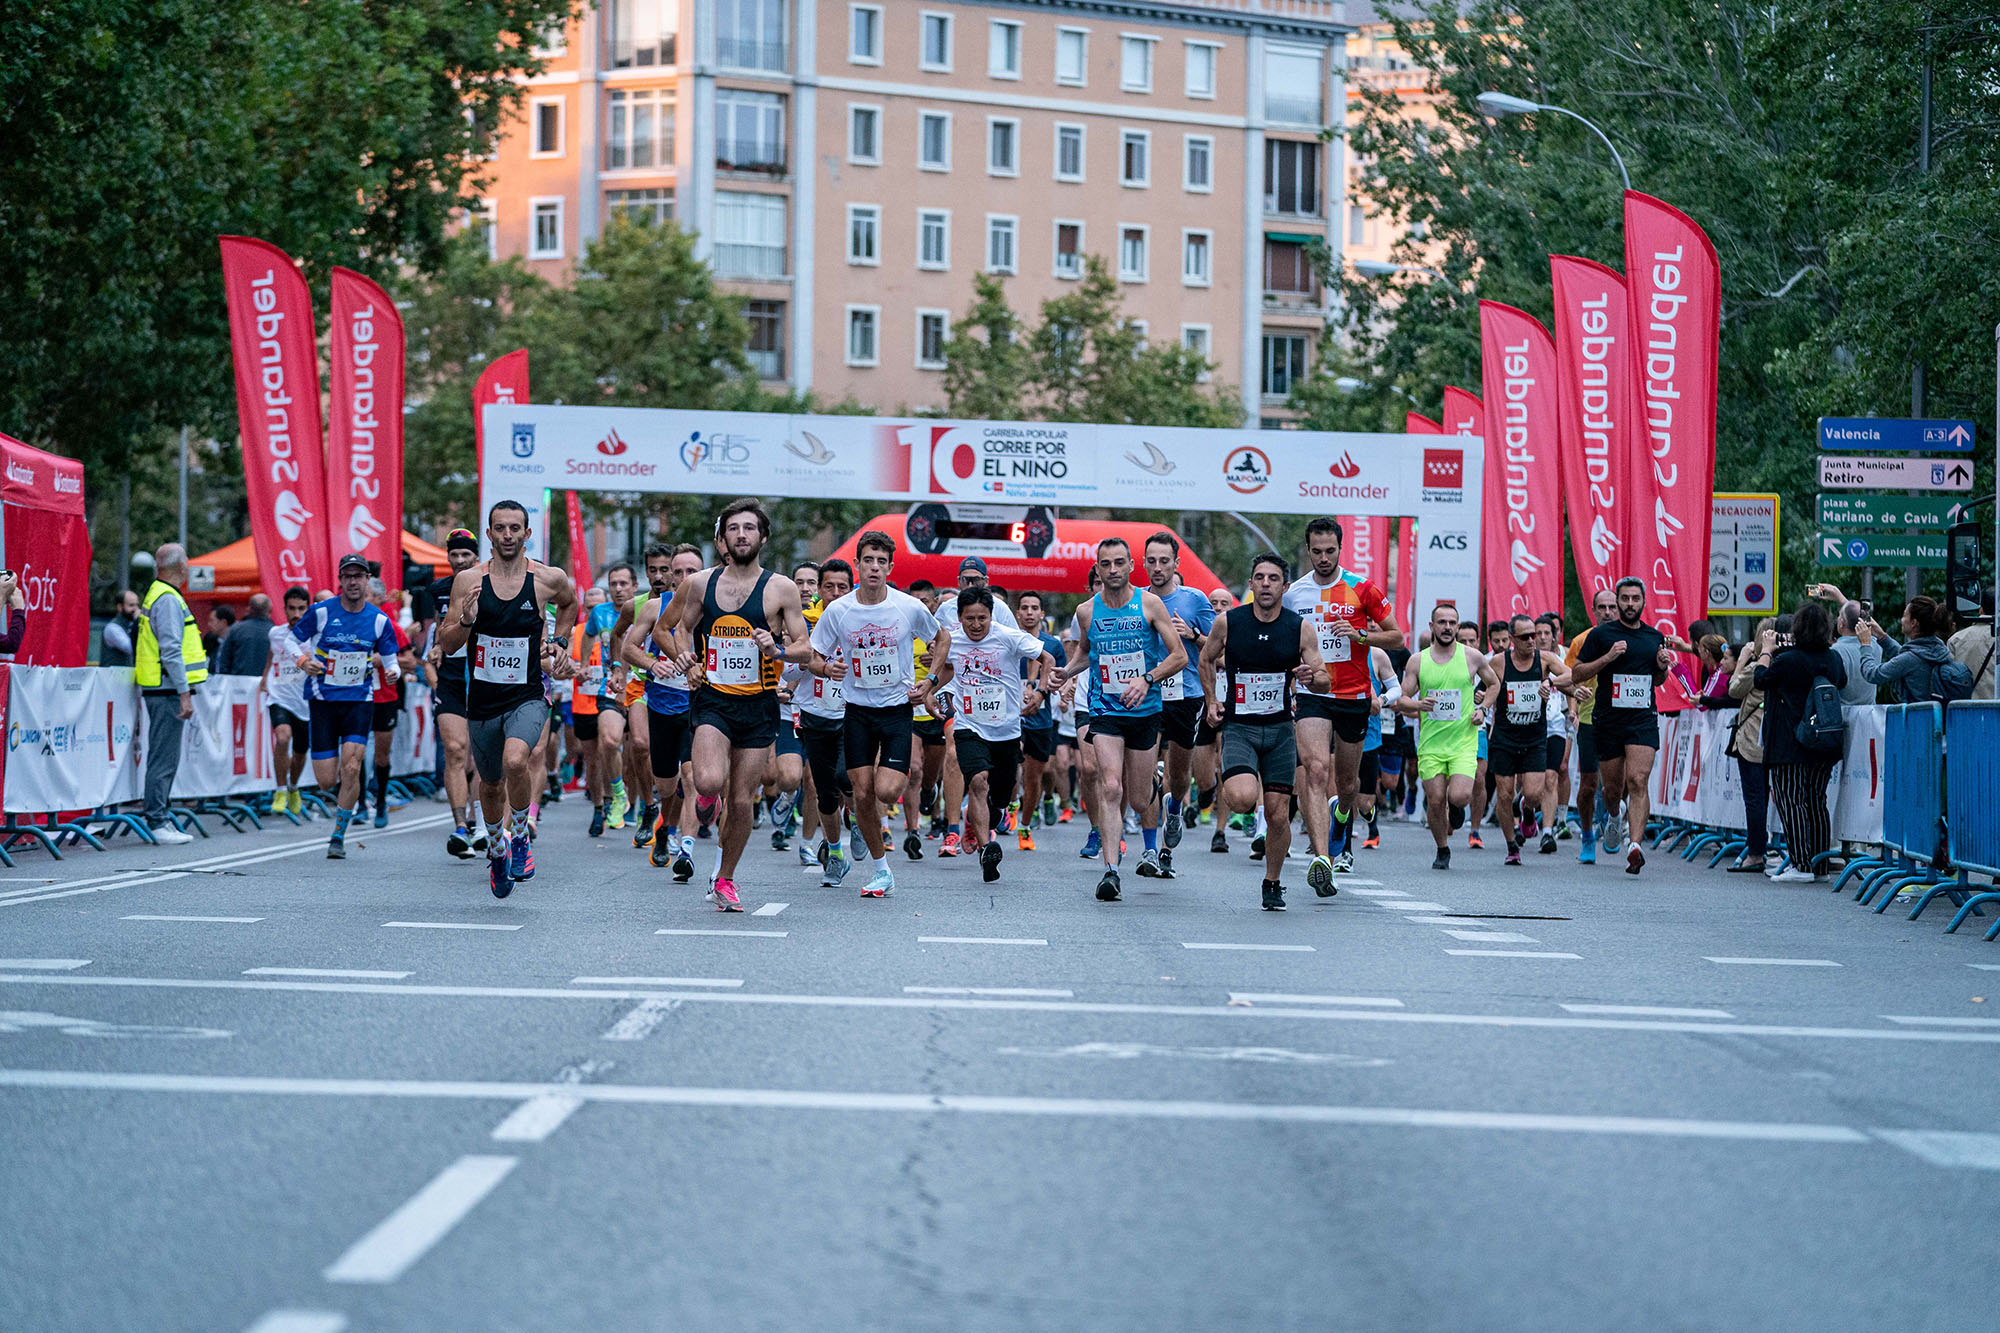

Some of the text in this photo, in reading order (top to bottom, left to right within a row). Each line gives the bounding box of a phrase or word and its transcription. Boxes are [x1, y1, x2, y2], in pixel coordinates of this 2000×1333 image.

[983, 428, 1068, 439] CARRERA POPULAR
[1824, 427, 1881, 440] Valencia
[983, 440, 1066, 455] CORRE POR
[500, 463, 545, 475] MADRID
[565, 458, 657, 476] Santander
[983, 455, 1068, 478] EL NIÑO
[1824, 460, 1905, 471] Junta Municipal
[1225, 474, 1269, 484] MAPOMA
[1824, 472, 1864, 484] Retiro
[1298, 481, 1390, 499] Santander
[1823, 499, 1867, 509] plaza de
[1711, 506, 1771, 517] RECAUCIÓN
[1823, 511, 1939, 525] Mariano de Cavia
[1010, 521, 1026, 544] 6
[1429, 535, 1468, 551] ACS
[1874, 547, 1911, 557] avenida
[1713, 589, 1726, 597] 30
[1329, 602, 1355, 614] Cris
[713, 626, 751, 637] STRIDERS
[1117, 621, 1143, 631] ULSA
[1322, 638, 1342, 650] 576
[491, 656, 521, 669] 1642
[722, 657, 752, 670] 1552
[342, 666, 359, 675] 143
[866, 663, 892, 676] 1591
[1114, 668, 1140, 681] 1721
[1252, 690, 1279, 702] 1397
[1521, 693, 1536, 702] 309
[1625, 688, 1645, 698] 1363
[977, 701, 1001, 712] 1847
[1439, 701, 1455, 711] 250
